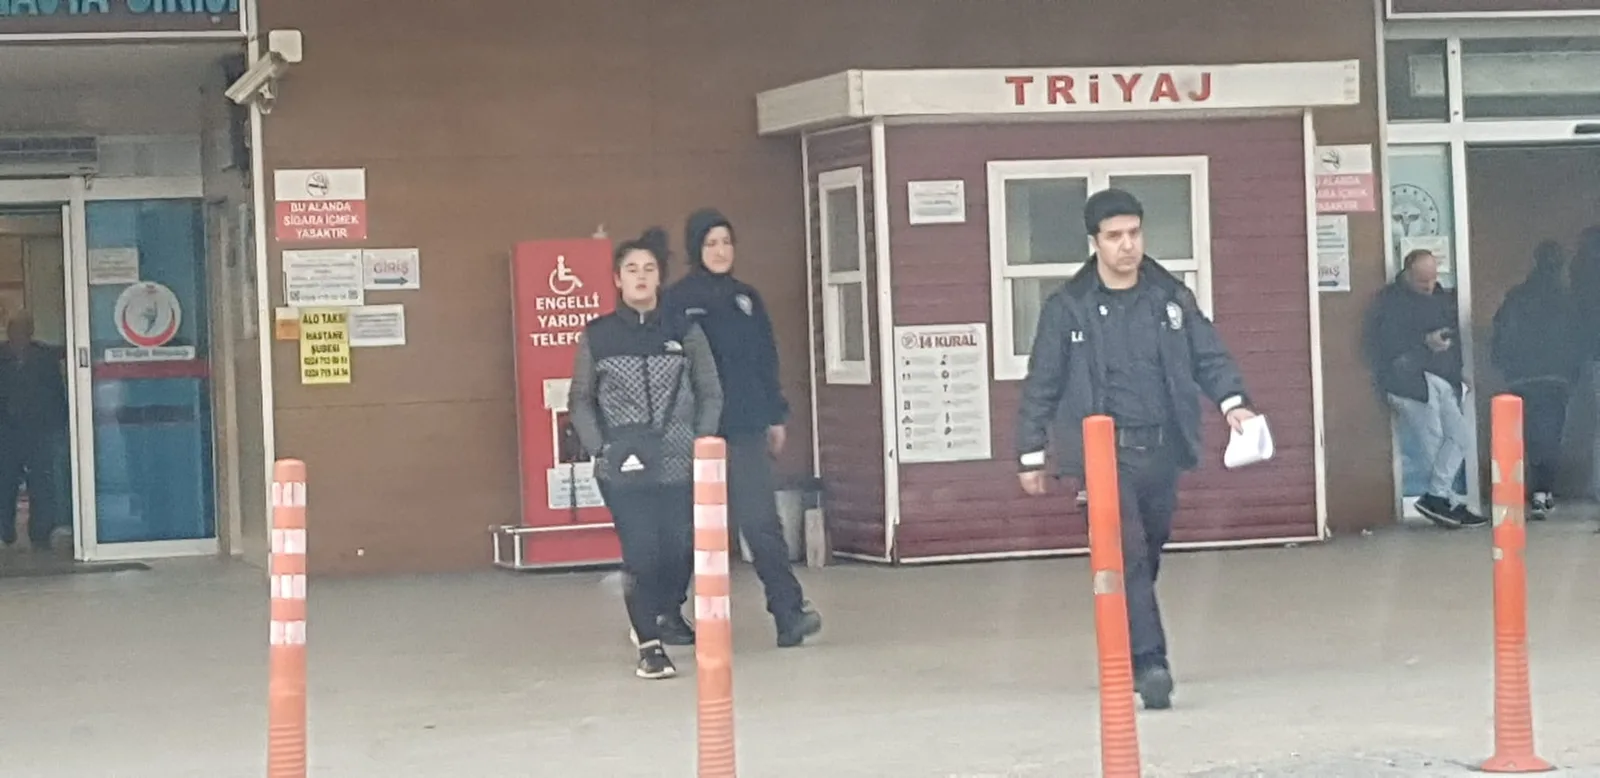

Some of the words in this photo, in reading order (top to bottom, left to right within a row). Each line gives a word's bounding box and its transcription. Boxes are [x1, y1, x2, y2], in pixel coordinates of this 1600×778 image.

[290, 202, 306, 212] BU
[308, 201, 352, 212] ALANDA
[283, 214, 324, 226] SİGARA
[325, 213, 360, 226] İÇMEK
[295, 228, 348, 239] YASAKTIR
[535, 292, 600, 311] ENGELLİ
[303, 313, 319, 324] ALO
[919, 335, 932, 348] 14
[935, 334, 977, 348] KURAL
